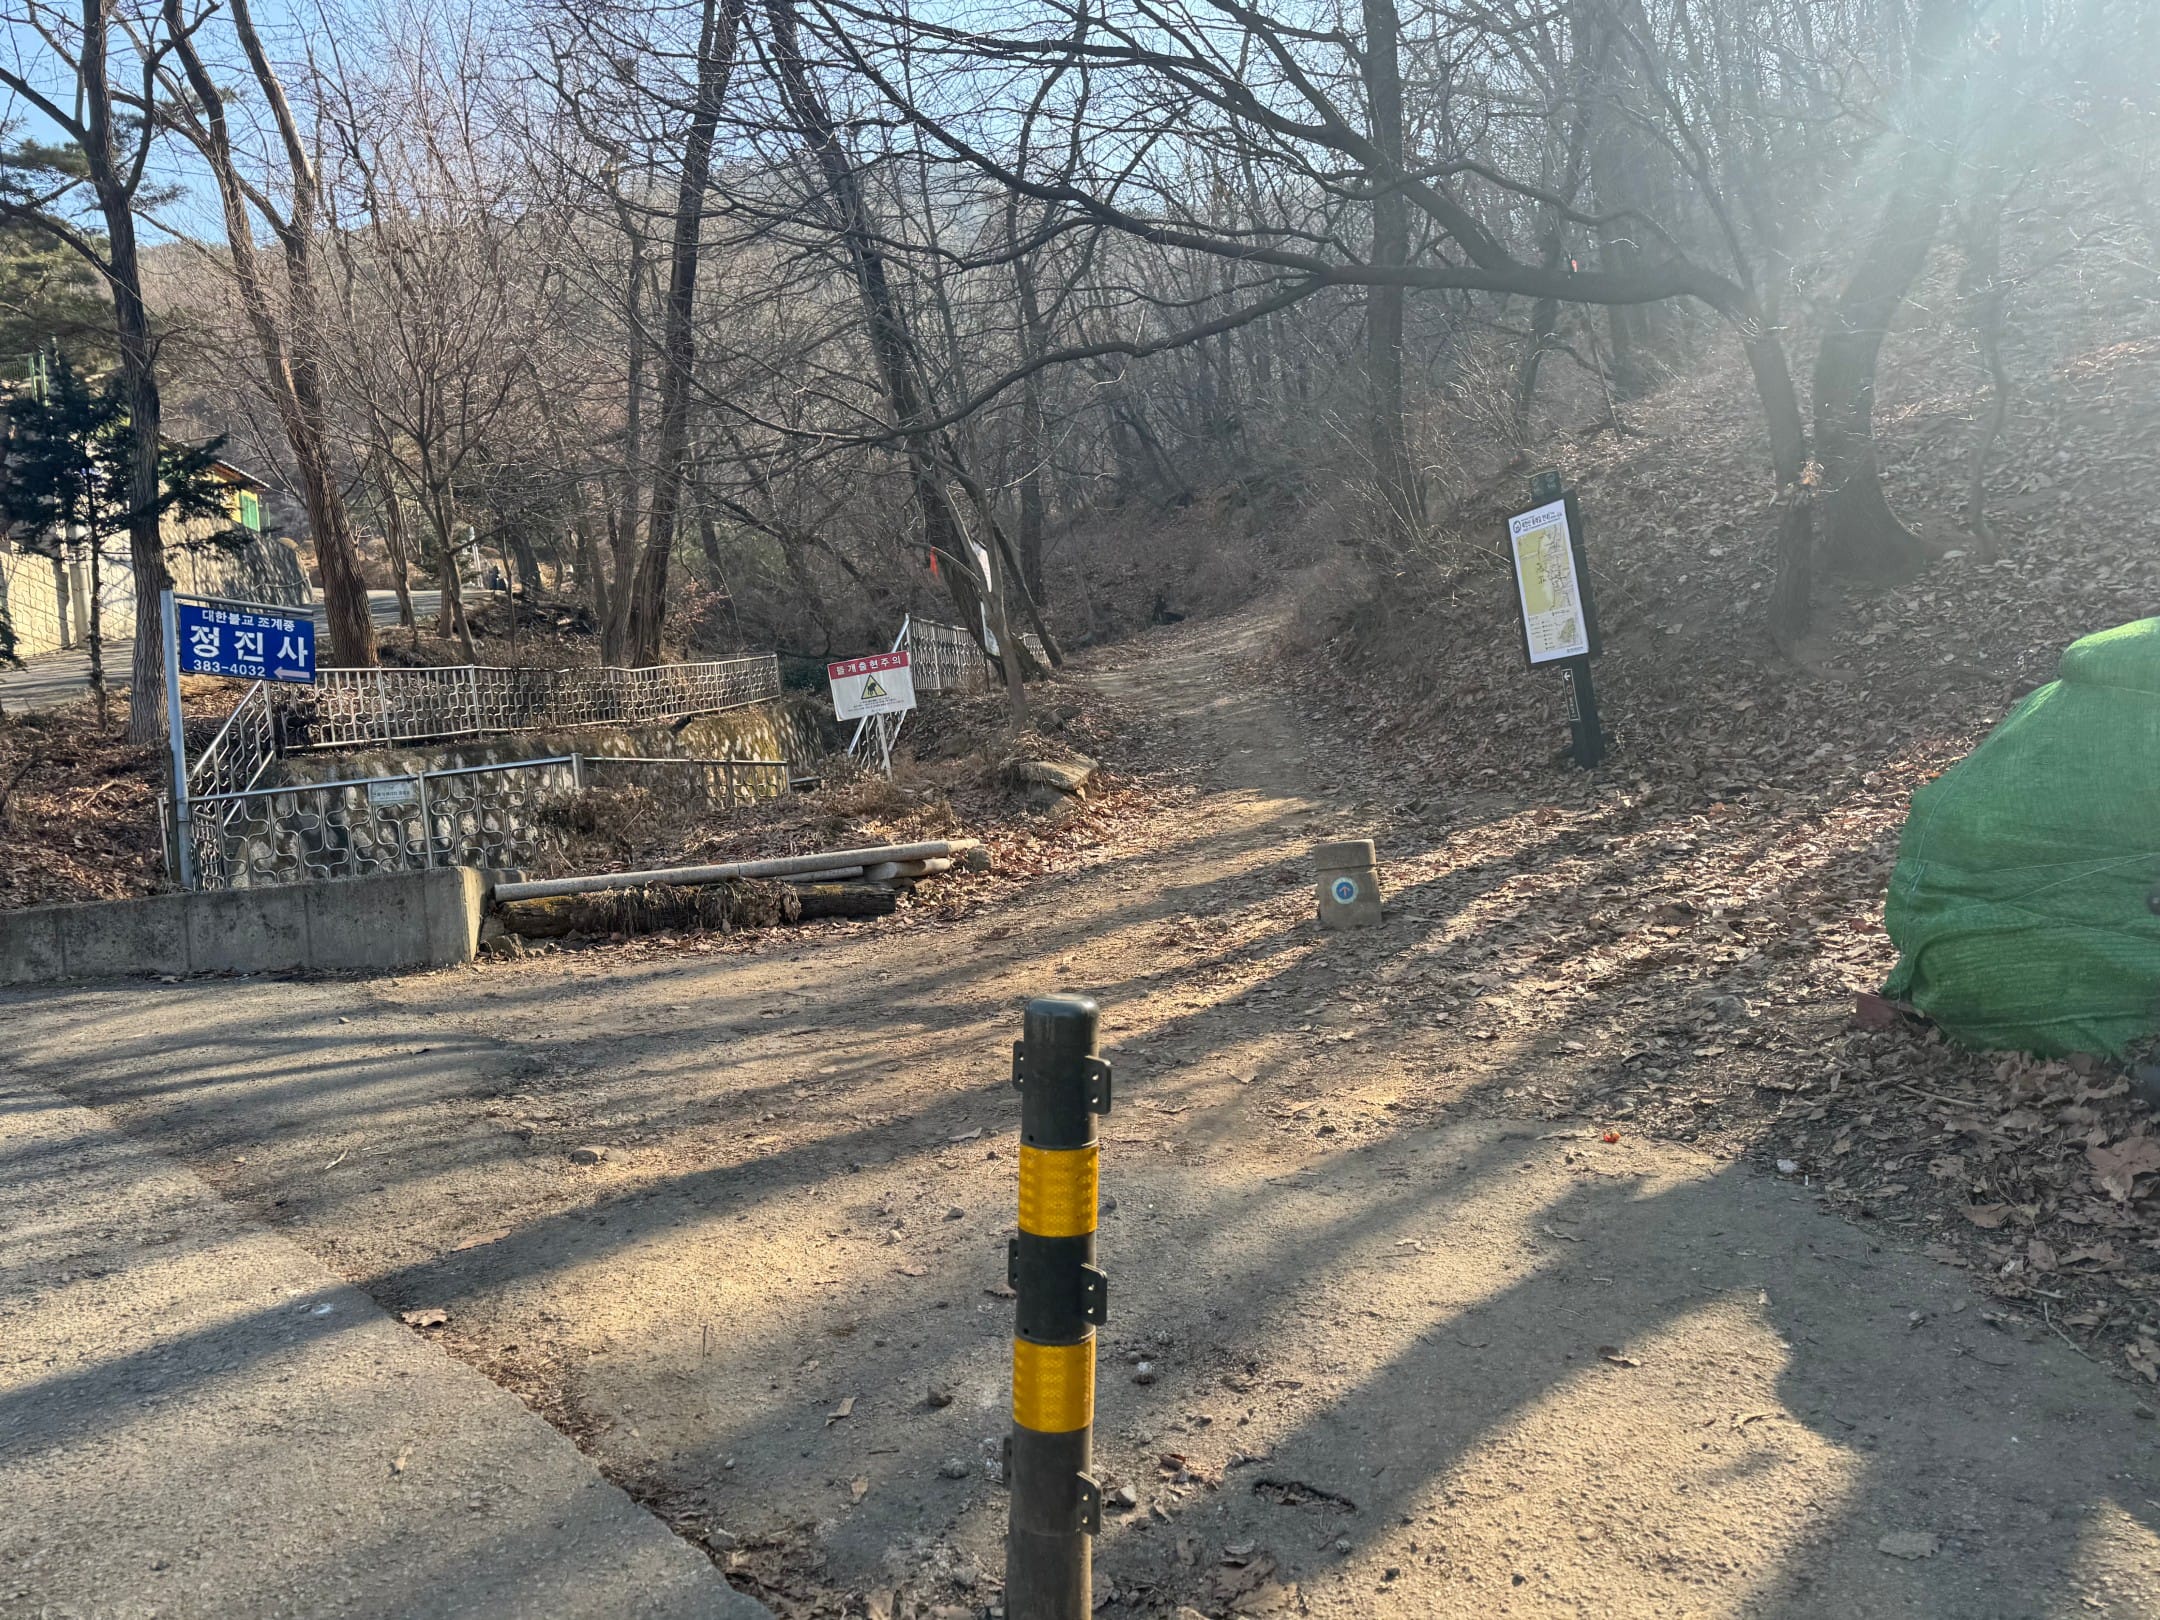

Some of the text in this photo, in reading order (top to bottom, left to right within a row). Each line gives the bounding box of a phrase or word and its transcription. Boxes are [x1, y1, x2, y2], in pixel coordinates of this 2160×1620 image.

[202, 609, 296, 632] 대한불교 조계종
[193, 659, 266, 677] 383-4032
